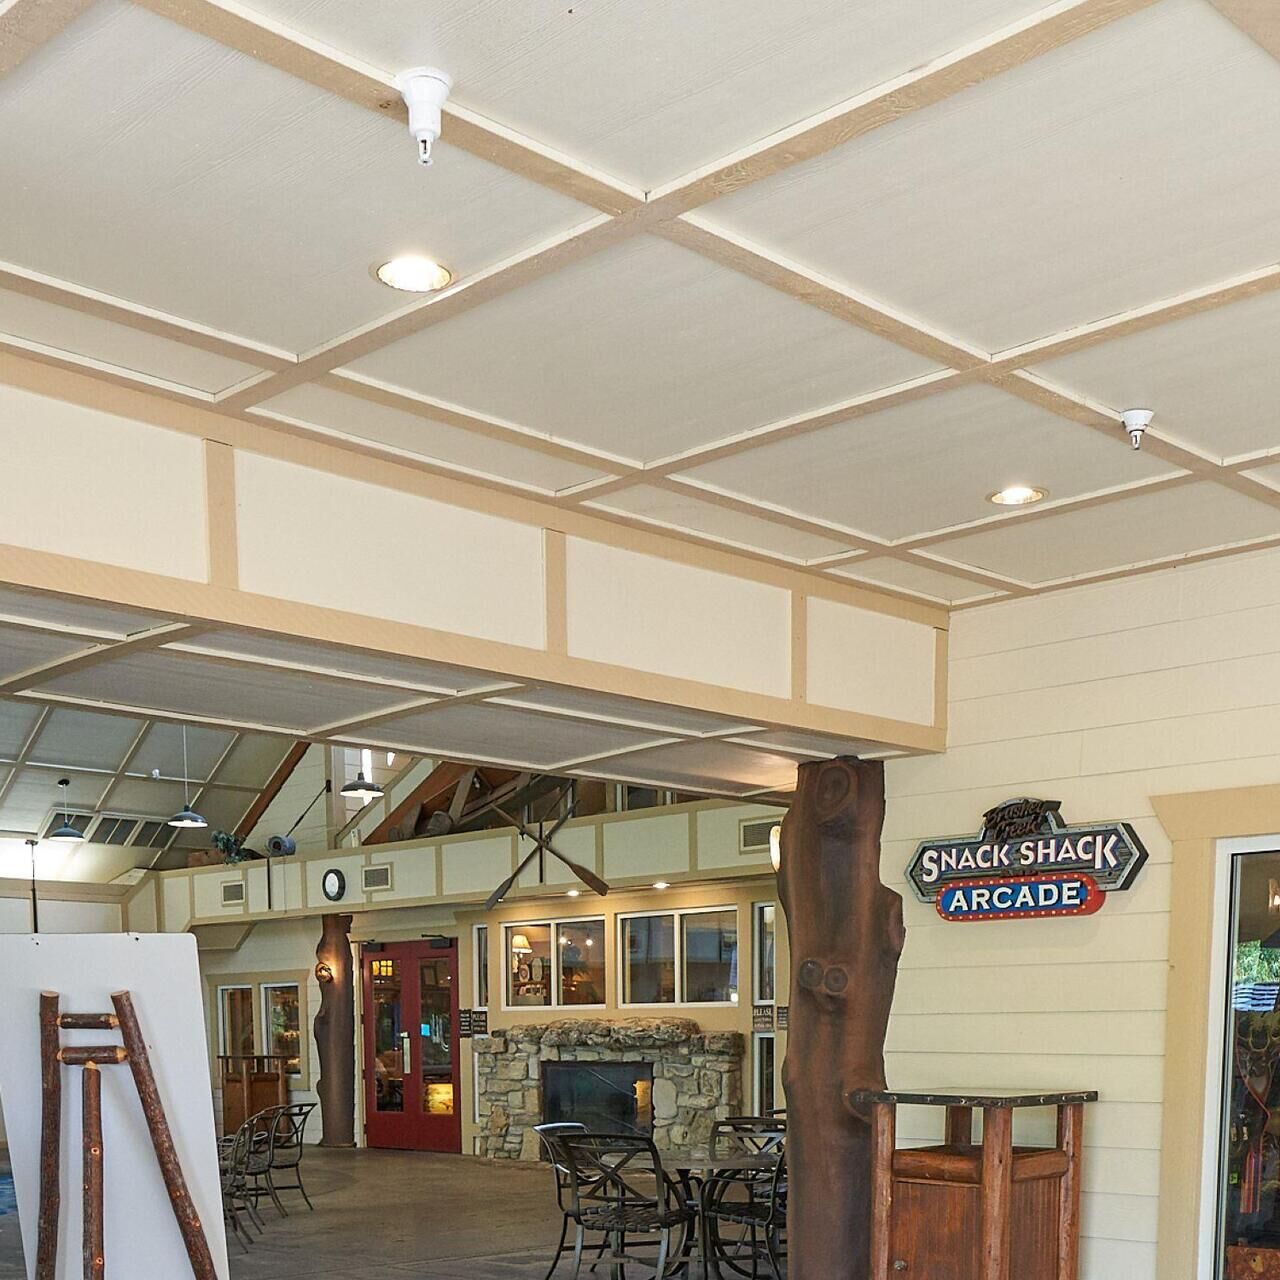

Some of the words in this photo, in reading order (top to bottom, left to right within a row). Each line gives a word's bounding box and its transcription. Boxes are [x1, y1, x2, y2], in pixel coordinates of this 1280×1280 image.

[993, 814, 1039, 842] Creek
[922, 844, 1010, 882] SNACK
[1020, 834, 1118, 870] SHACK
[949, 881, 1081, 911] ARCADE
